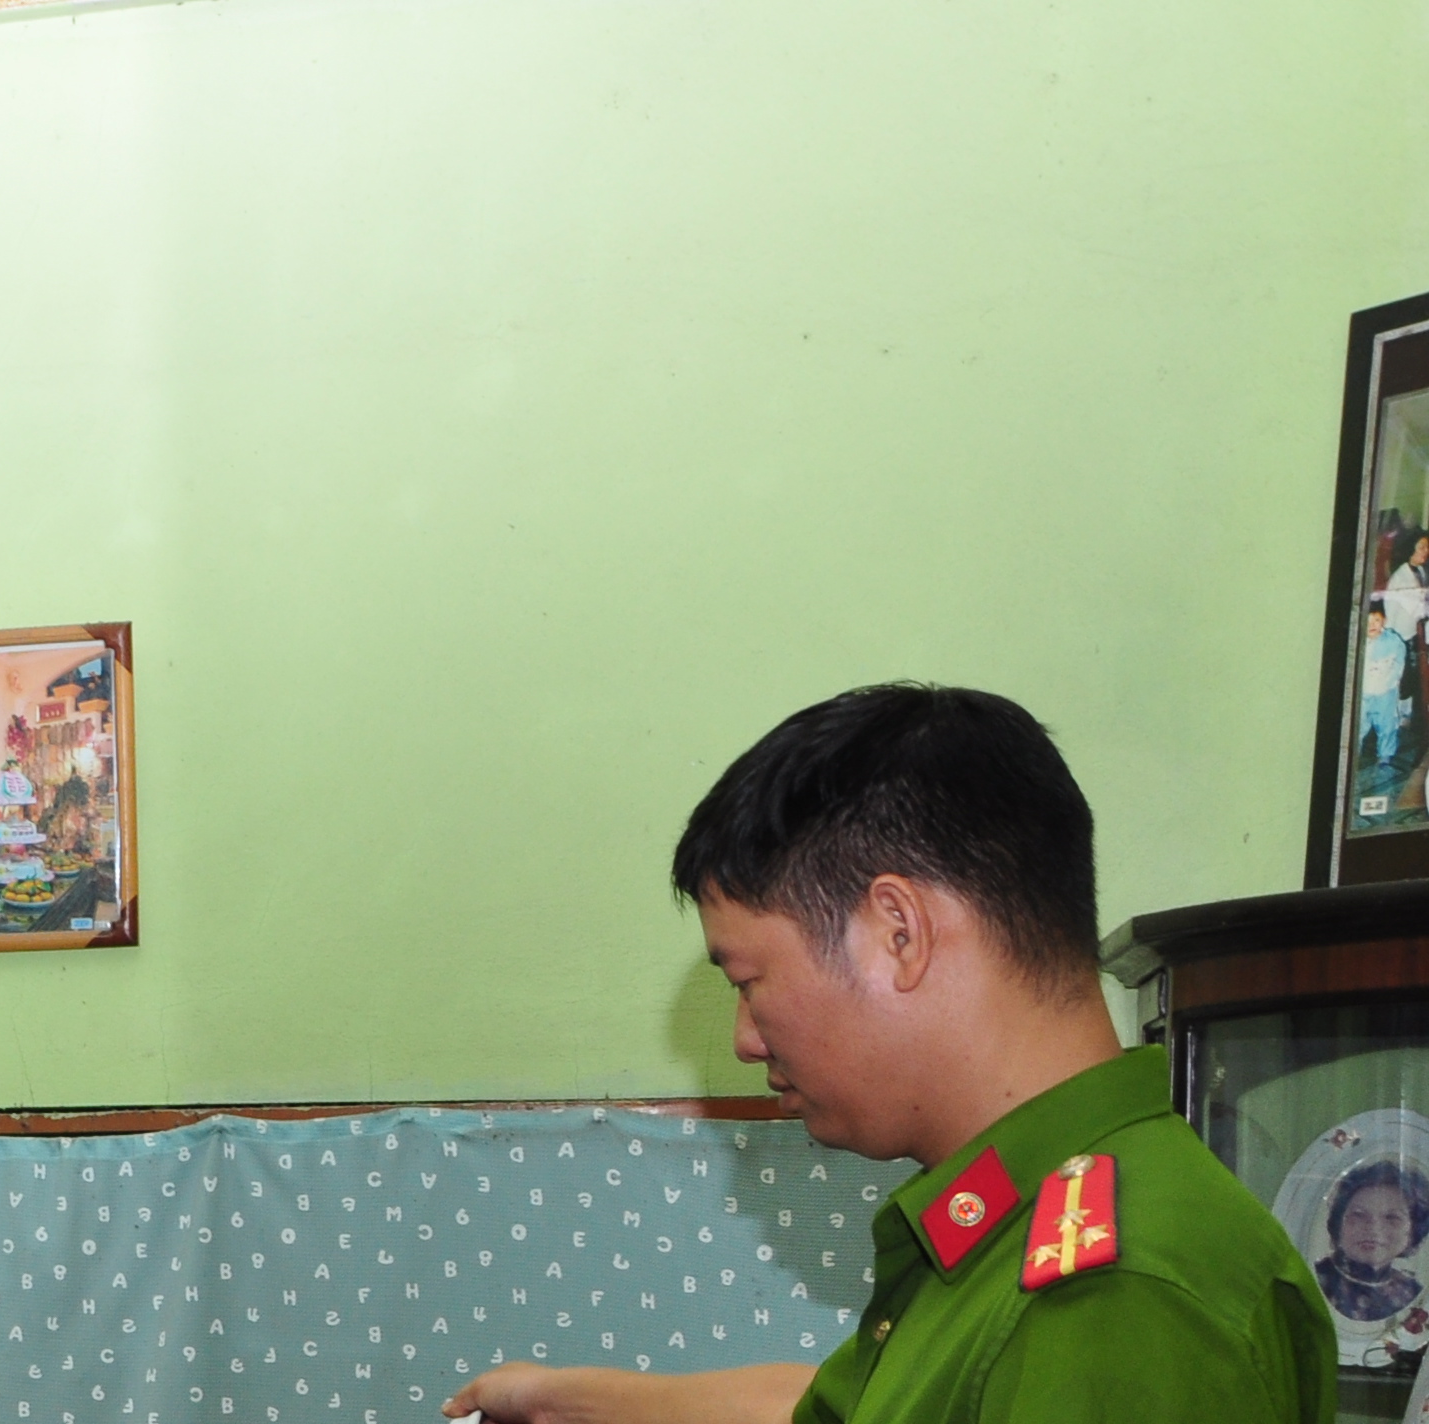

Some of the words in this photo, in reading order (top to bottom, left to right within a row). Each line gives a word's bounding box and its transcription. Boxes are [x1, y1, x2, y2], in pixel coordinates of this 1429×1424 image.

[350, 1120, 363, 1135] E
[224, 1143, 235, 1159] H
[443, 1141, 457, 1157] H
[321, 1150, 336, 1165] A
[34, 1164, 46, 1179] H
[119, 1161, 133, 1176] A
[368, 1172, 381, 1187] C
[162, 1182, 175, 1197] C
[386, 1207, 402, 1221] M
[339, 1234, 351, 1249] E
[136, 1243, 147, 1258] E
[220, 1263, 232, 1279] B
[315, 1264, 329, 1279] A
[445, 1261, 457, 1277] B
[22, 1274, 32, 1289] B
[113, 1273, 127, 1288] A
[186, 1287, 198, 1301] H
[284, 1290, 296, 1305] H
[358, 1288, 370, 1303] F
[406, 1283, 419, 1299] H
[83, 1299, 95, 1314] H
[153, 1295, 164, 1310] F
[210, 1319, 223, 1335] A
[432, 1317, 448, 1334] A
[9, 1326, 22, 1341] A
[100, 1349, 114, 1363] C
[303, 1341, 317, 1356] C
[18, 1401, 30, 1417] B
[222, 1397, 233, 1414] B
[365, 1409, 377, 1424] E
